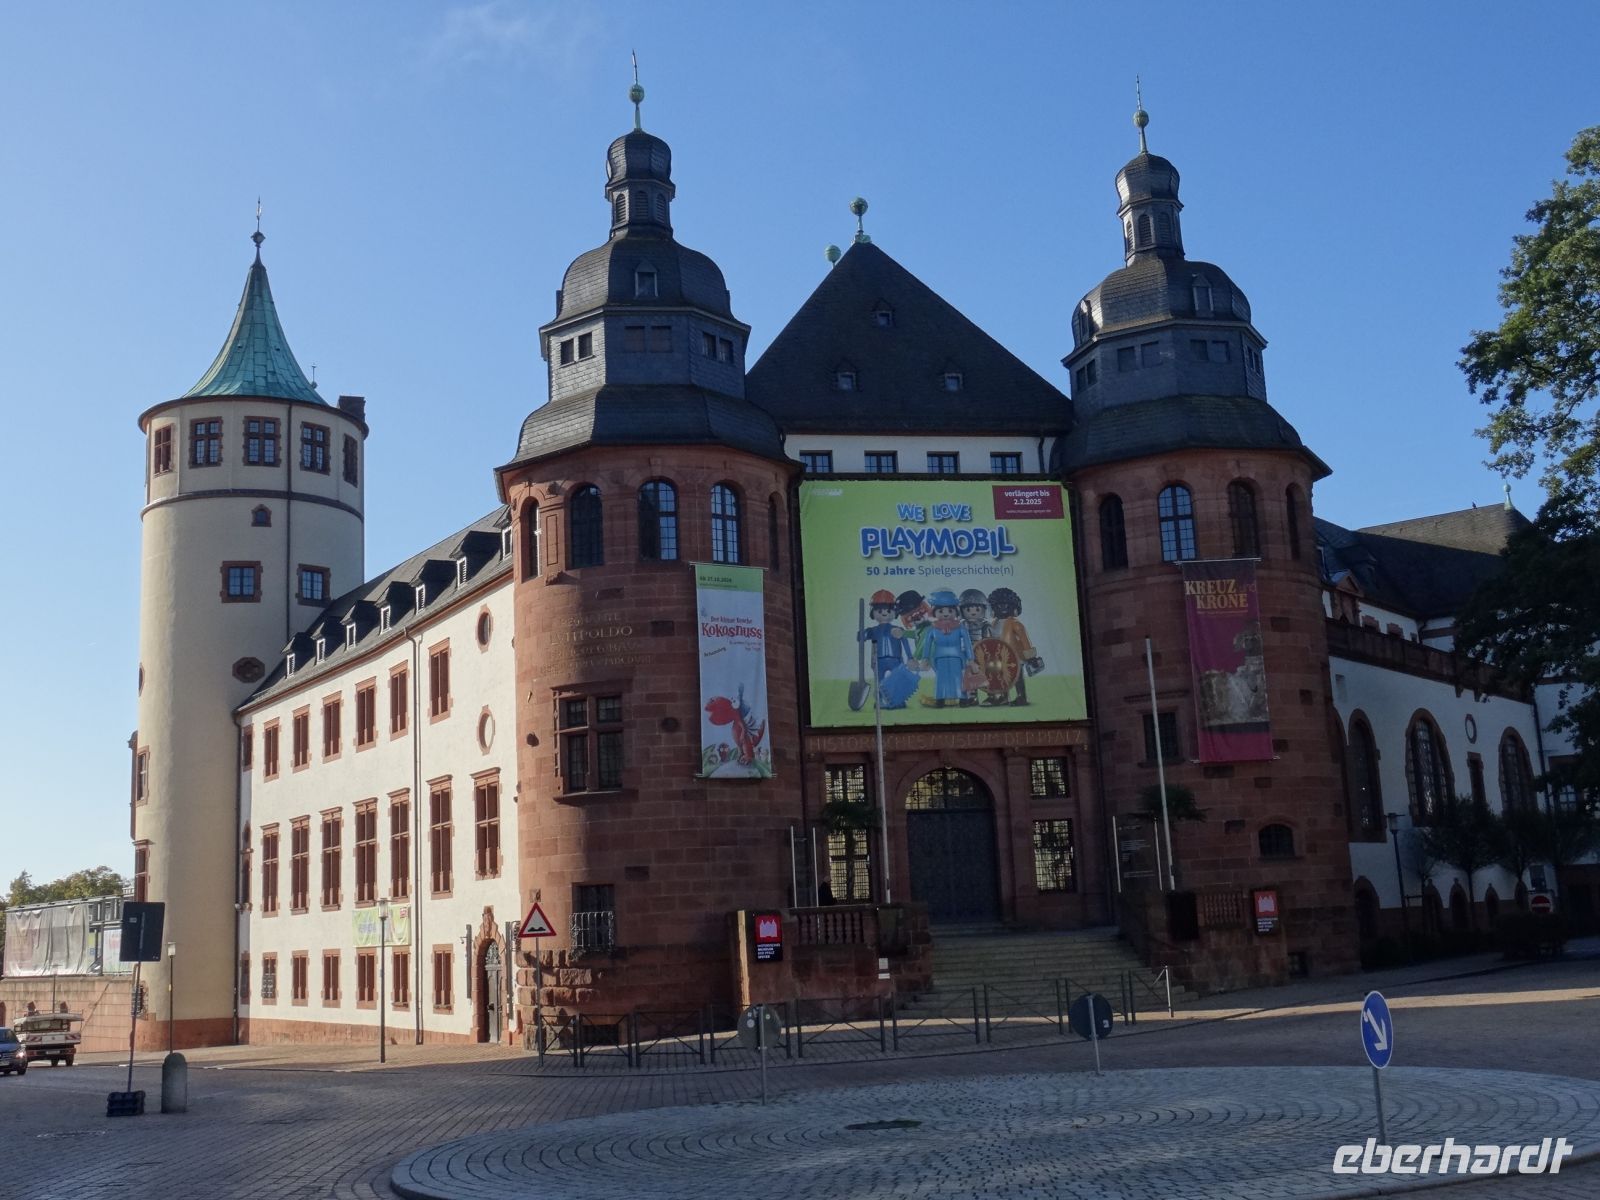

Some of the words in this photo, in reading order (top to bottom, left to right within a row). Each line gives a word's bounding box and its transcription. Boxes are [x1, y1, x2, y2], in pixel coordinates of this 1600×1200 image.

[1004, 489, 1039, 498] verlängert
[1039, 489, 1050, 497] bis
[896, 503, 925, 522] WE
[931, 503, 971, 521] LOVE
[860, 525, 1017, 558] PLAYMOBIL
[866, 566, 880, 576] 50
[883, 565, 916, 576] Jahre
[918, 564, 1015, 578] Spielgeschichte(n)
[1184, 579, 1236, 594] KREUZ
[1196, 593, 1248, 608] KRONE
[701, 622, 762, 639] Kokosnuss
